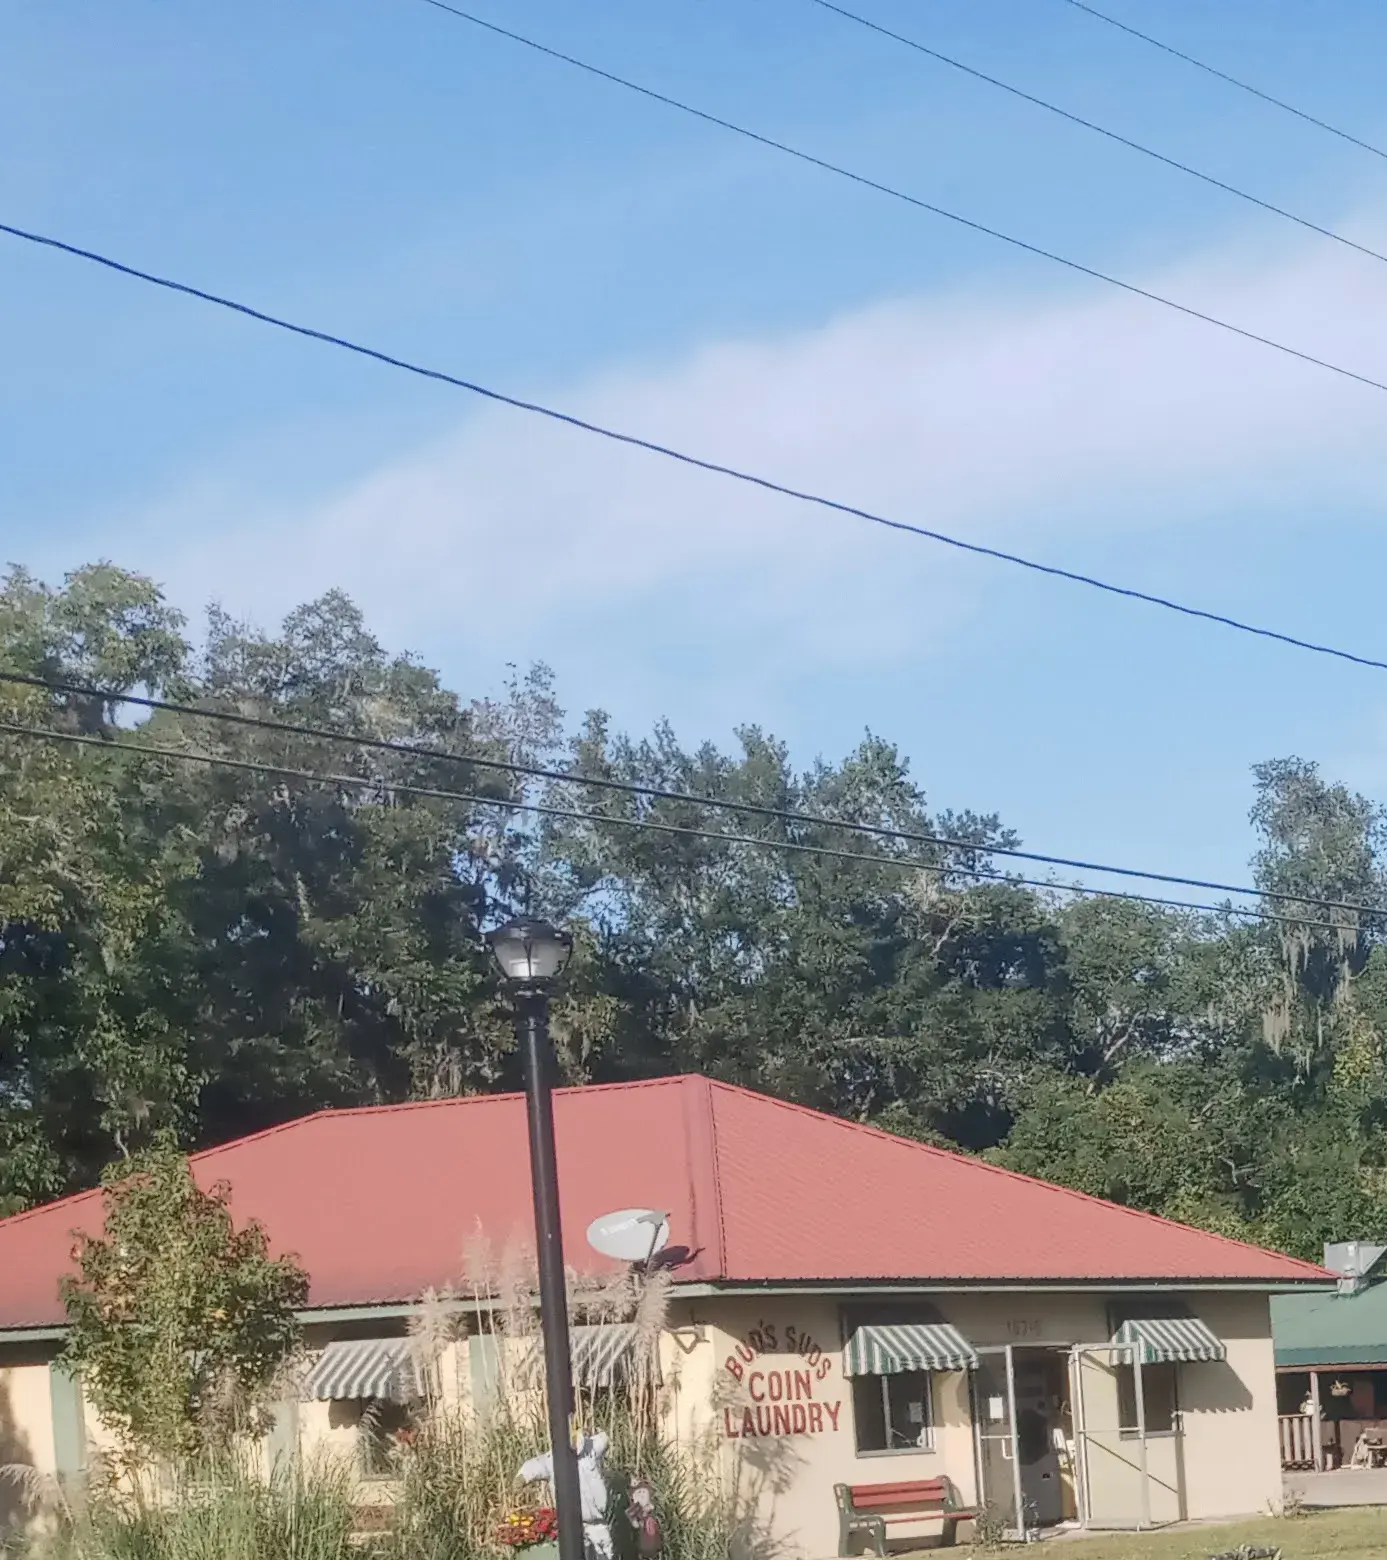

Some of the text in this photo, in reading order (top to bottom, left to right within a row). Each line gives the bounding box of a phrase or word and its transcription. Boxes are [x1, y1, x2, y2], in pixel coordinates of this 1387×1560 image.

[725, 1318, 832, 1382] BUD'S SUDS
[748, 1369, 813, 1402] COIN
[723, 1401, 842, 1438] LAUNDRY
